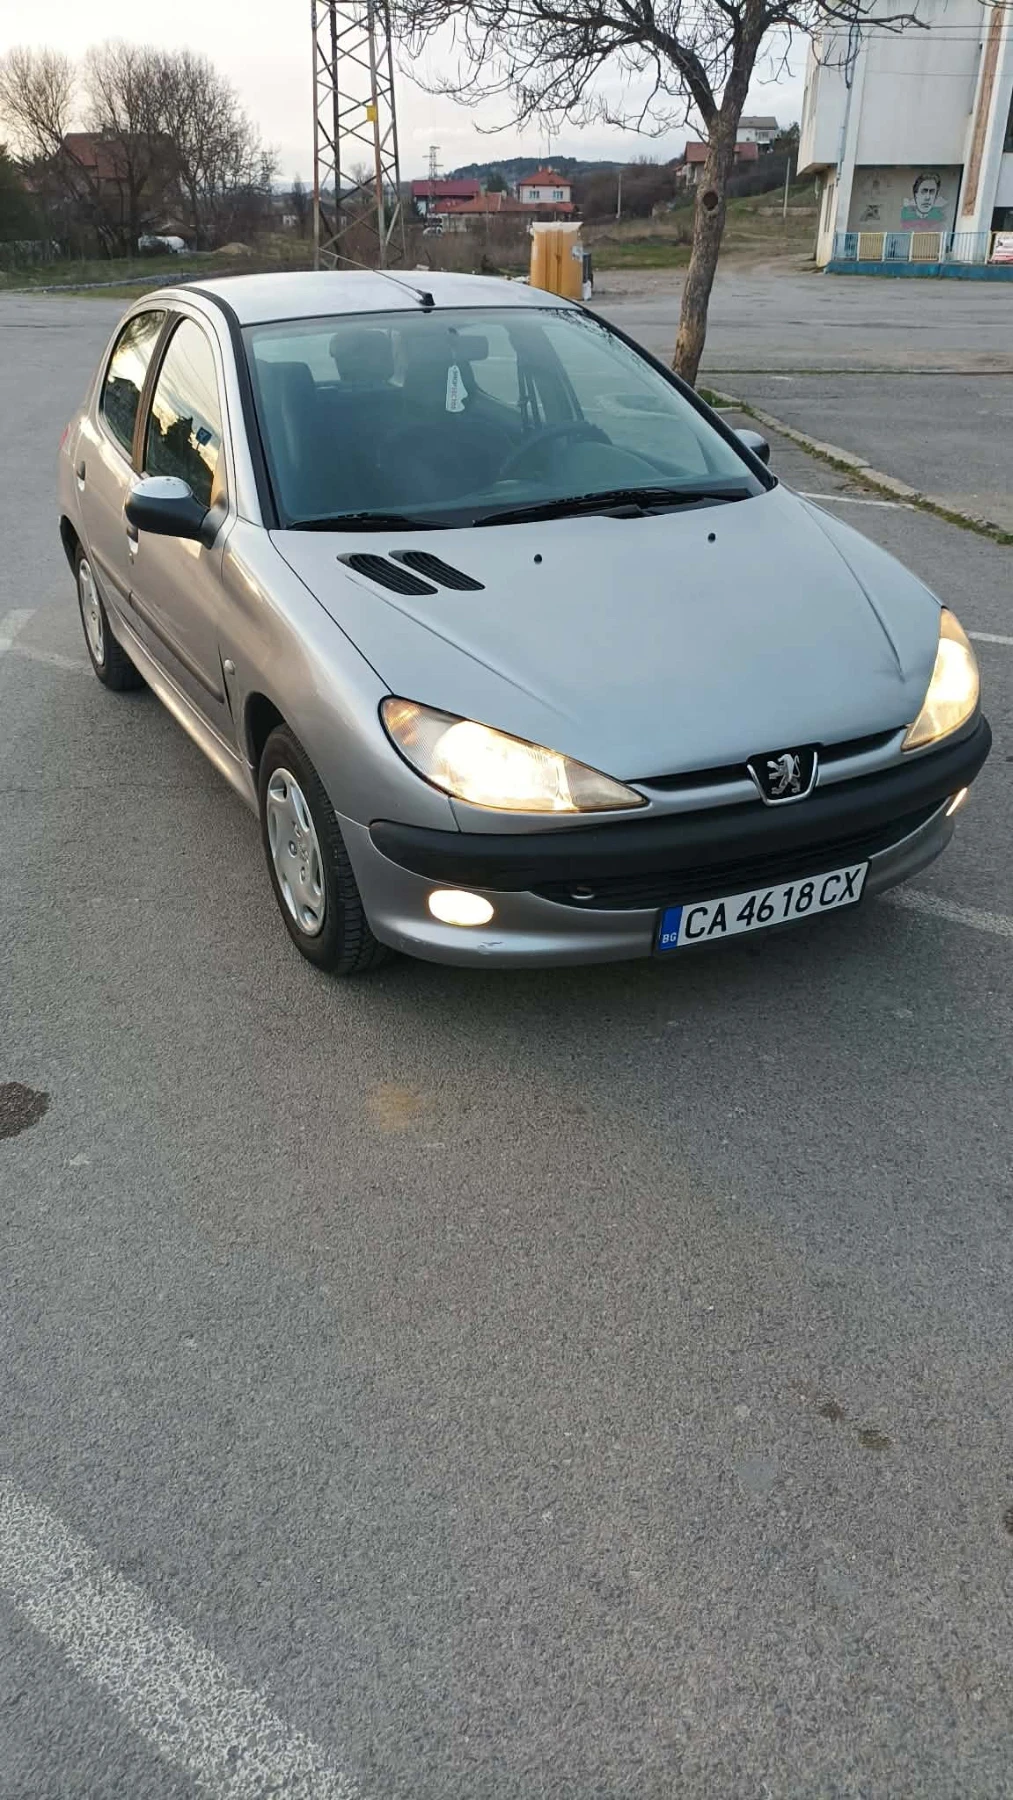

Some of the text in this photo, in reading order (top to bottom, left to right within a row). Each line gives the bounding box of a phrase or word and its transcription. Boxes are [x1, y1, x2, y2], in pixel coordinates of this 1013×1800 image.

[685, 868, 862, 939] CA 4618 CX
[661, 932, 677, 944] BG
